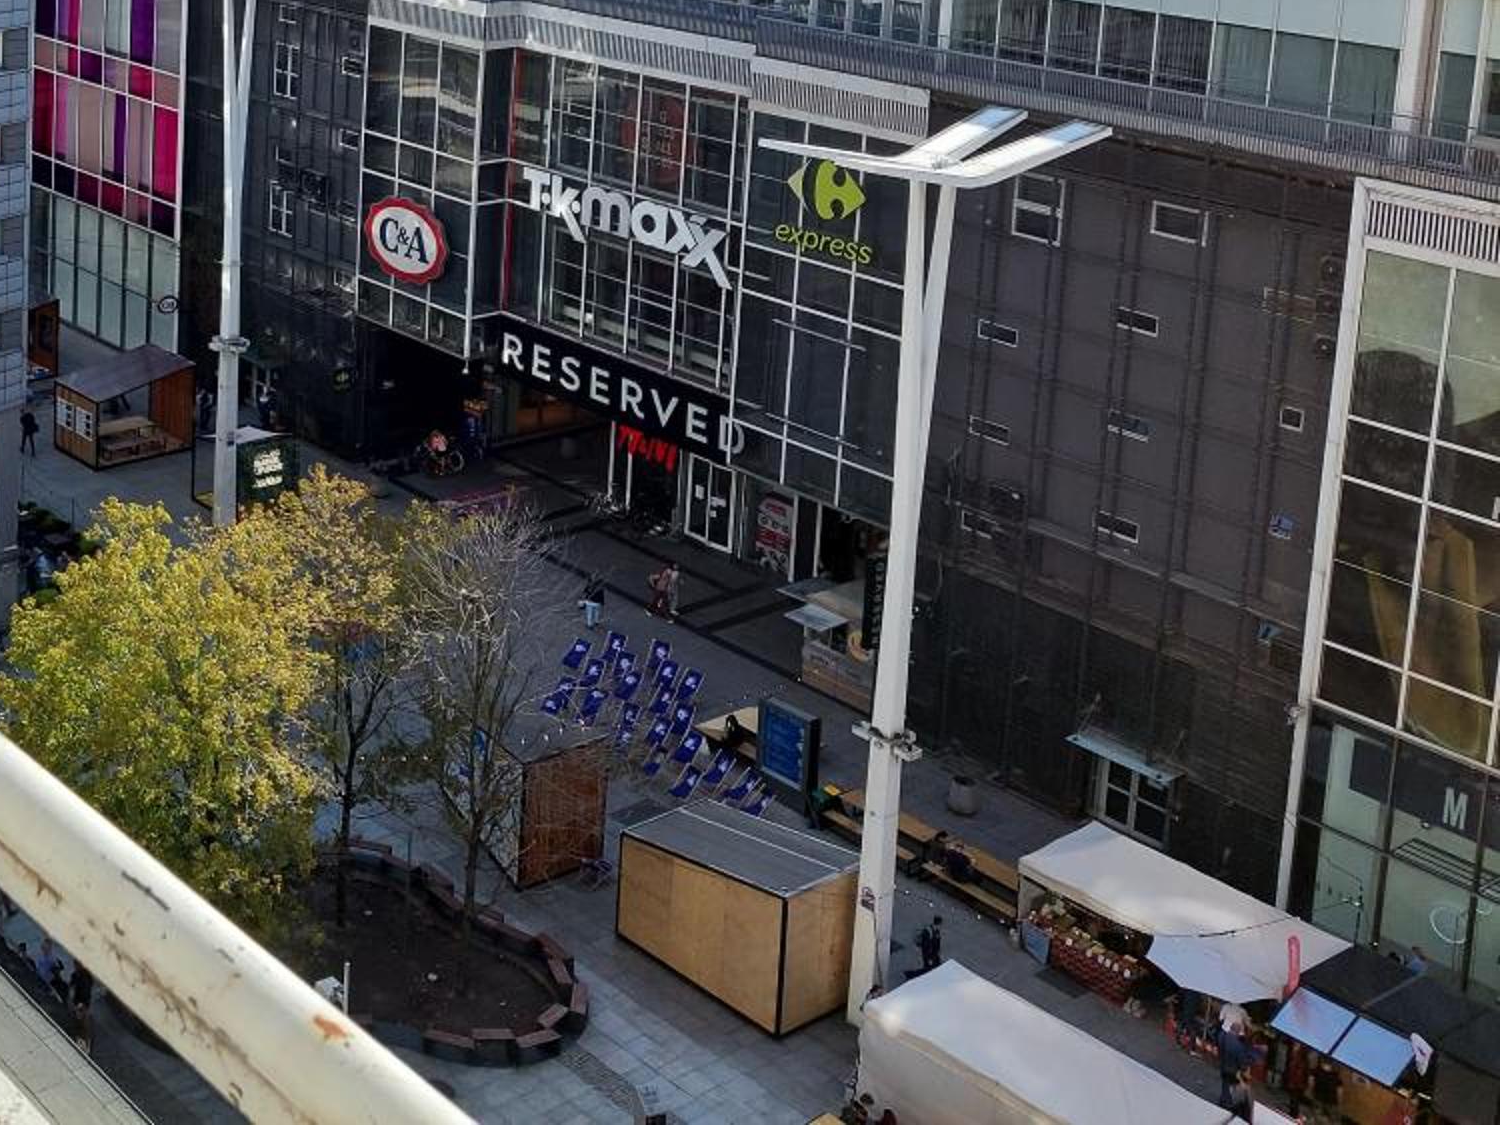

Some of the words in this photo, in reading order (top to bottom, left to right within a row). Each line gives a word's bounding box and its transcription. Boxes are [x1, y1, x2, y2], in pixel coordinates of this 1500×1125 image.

[380, 217, 429, 264] C&A
[775, 224, 873, 264] express
[502, 331, 746, 455] RESERVED
[1443, 786, 1469, 830] M
